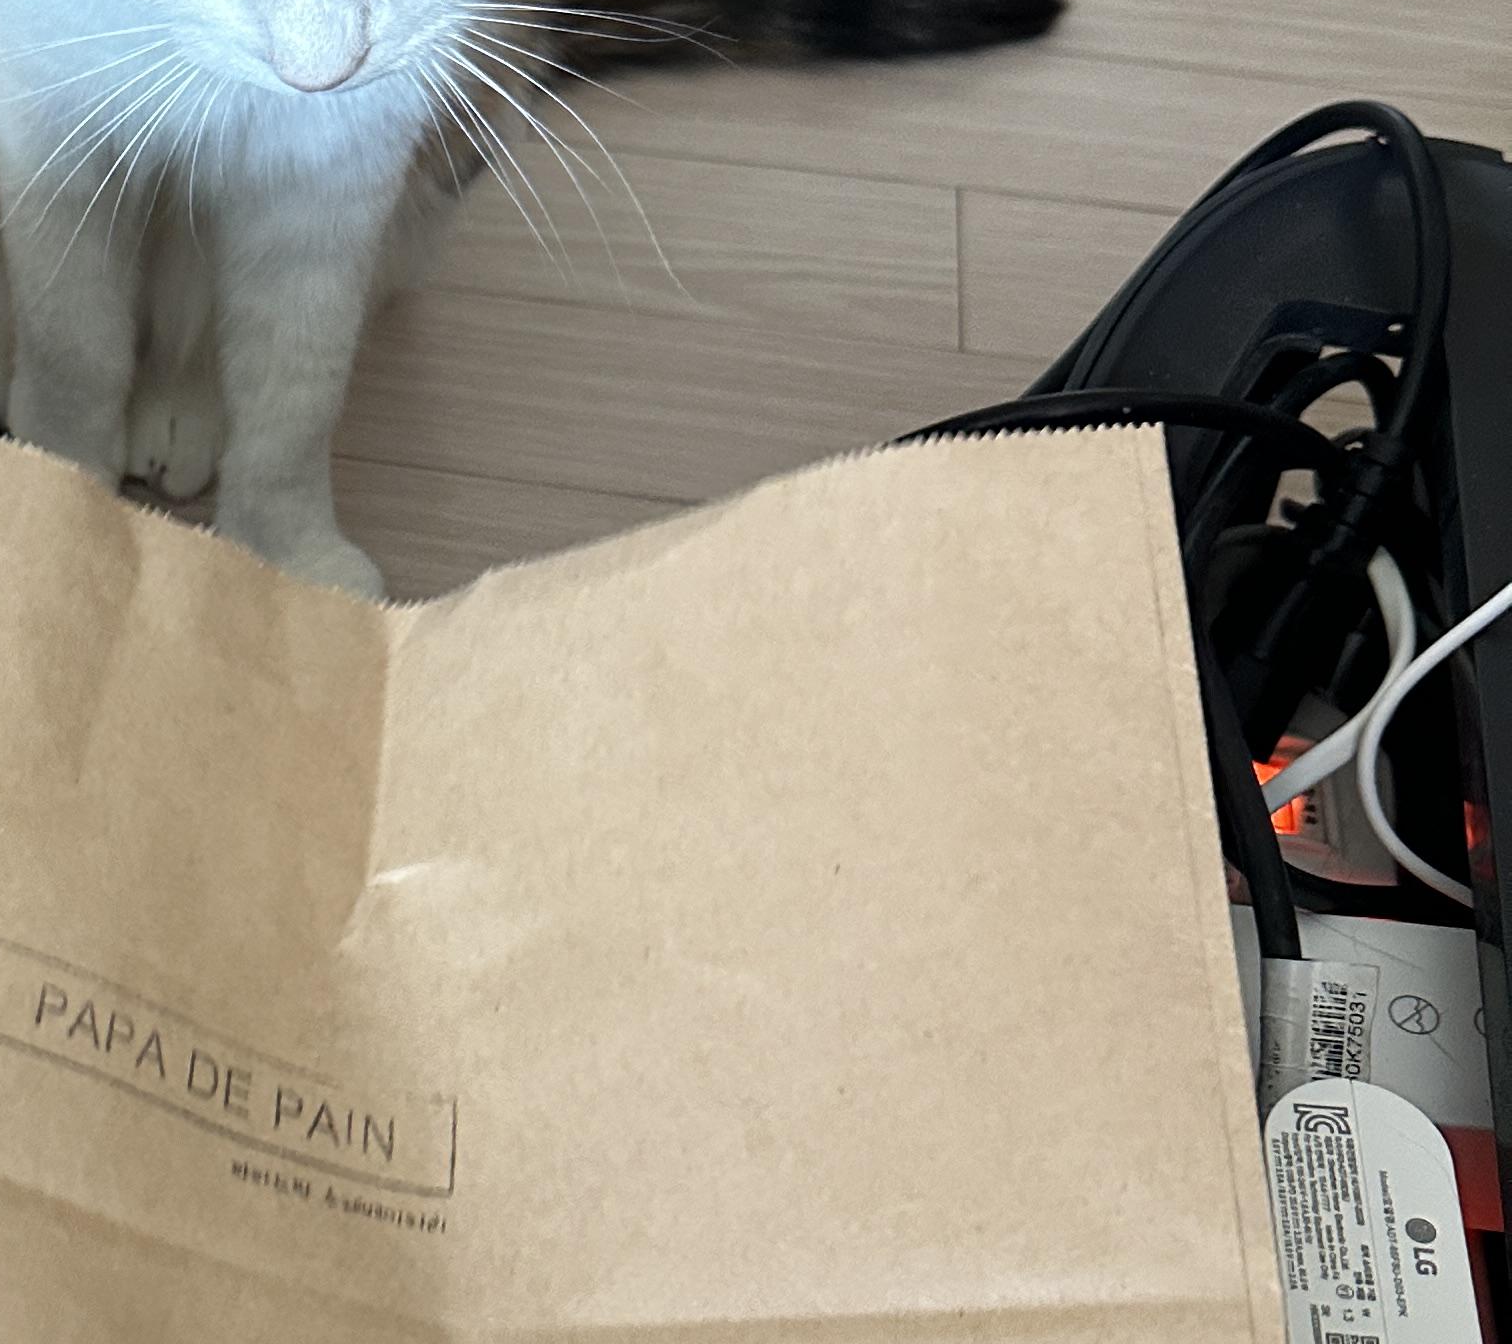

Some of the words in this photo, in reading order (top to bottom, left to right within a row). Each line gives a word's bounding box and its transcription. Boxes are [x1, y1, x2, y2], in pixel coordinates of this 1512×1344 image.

[34, 982, 167, 1080] PAPA
[187, 1047, 253, 1119] DE
[273, 1085, 395, 1163] PAIN
[1345, 992, 1368, 1080] 0K75031
[1413, 1246, 1438, 1277] LG
